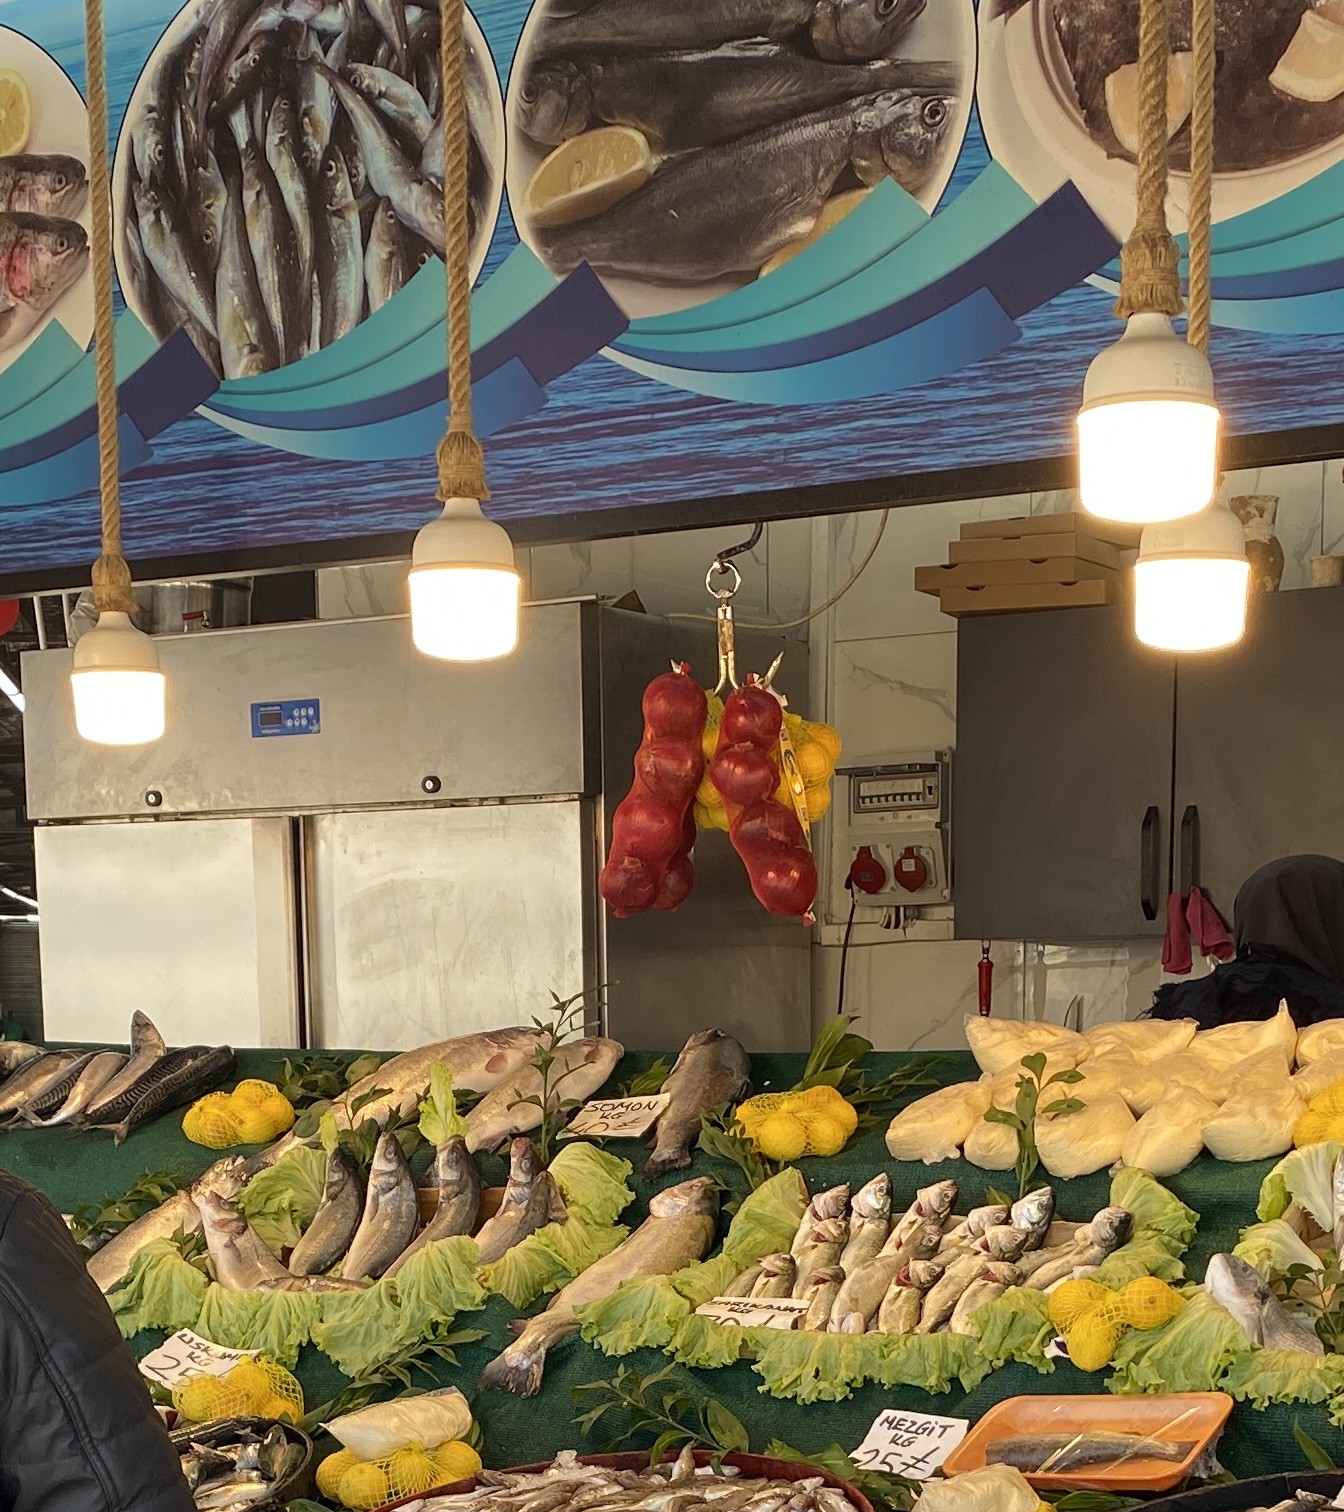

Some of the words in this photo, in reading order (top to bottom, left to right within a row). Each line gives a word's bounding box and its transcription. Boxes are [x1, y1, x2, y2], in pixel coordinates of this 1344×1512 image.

[583, 1101, 659, 1113] SOMON
[599, 1111, 626, 1120] KG
[186, 1351, 215, 1367] KG
[879, 1415, 956, 1439] MEZGİT
[888, 1433, 919, 1448] KG
